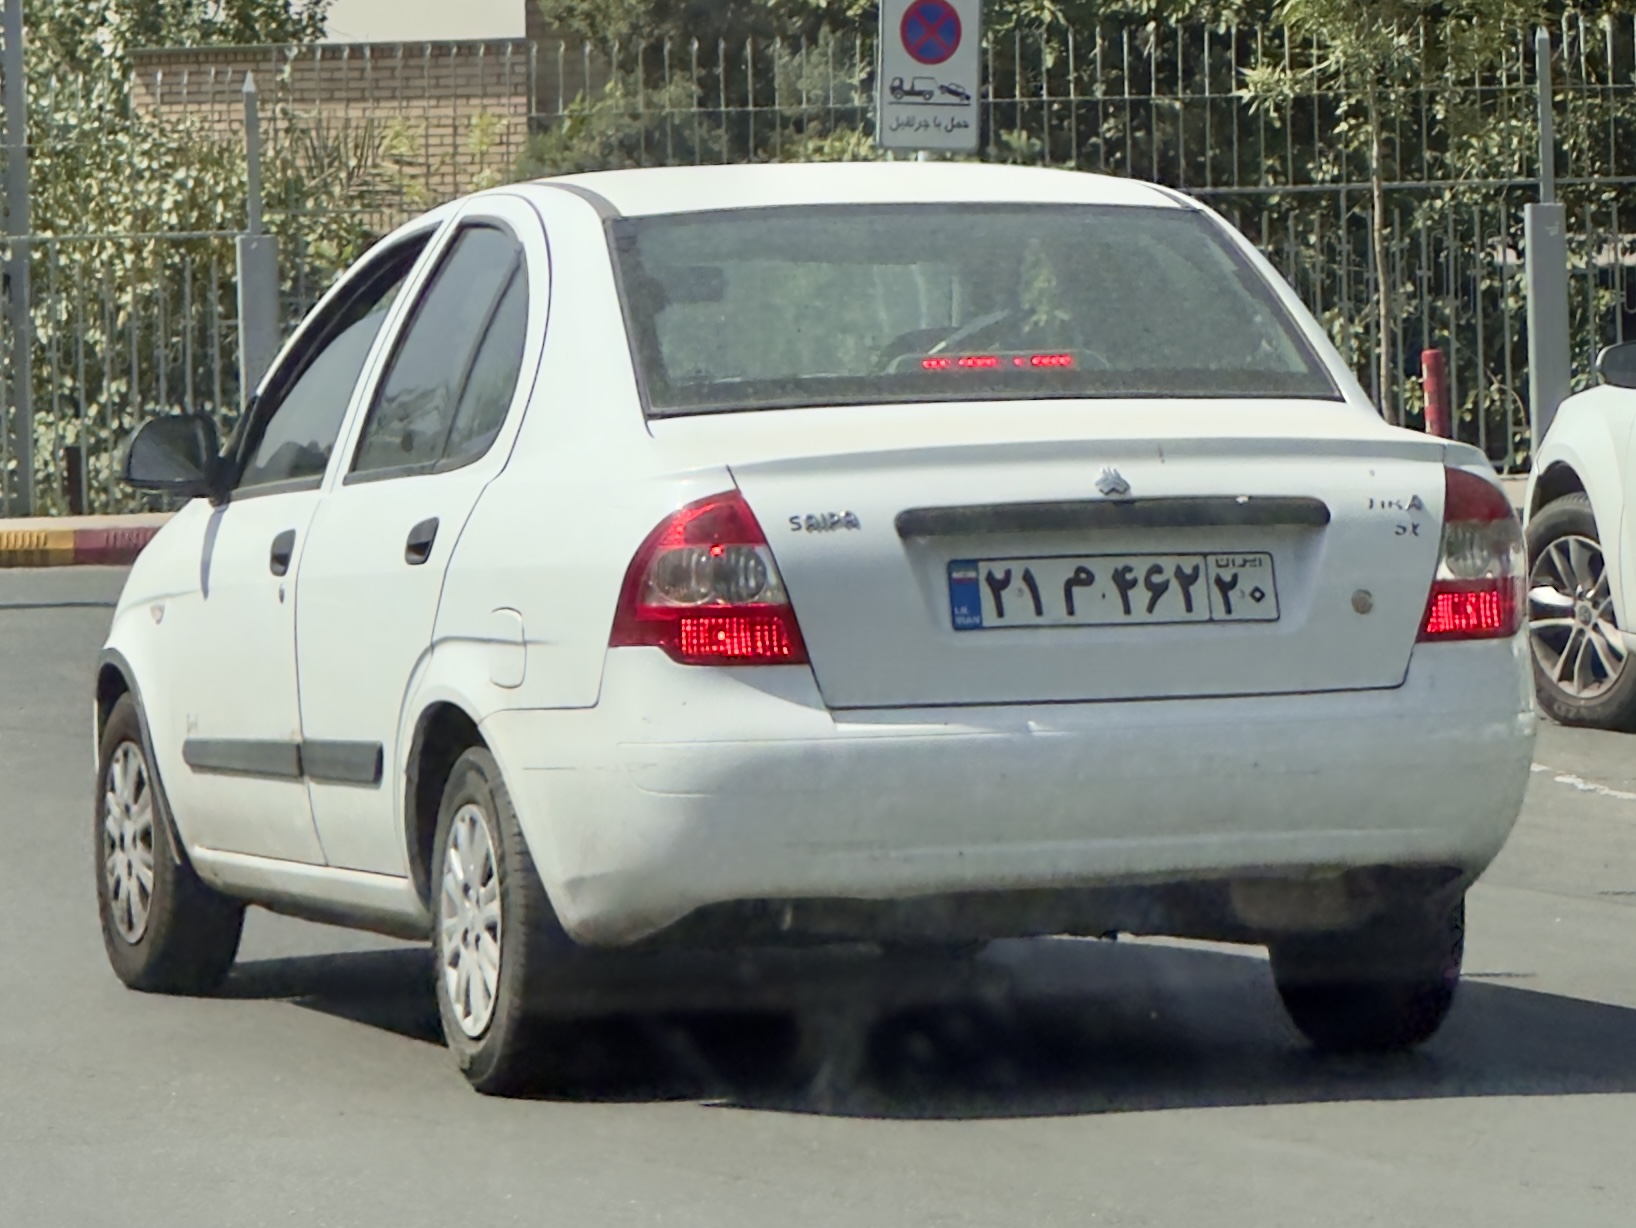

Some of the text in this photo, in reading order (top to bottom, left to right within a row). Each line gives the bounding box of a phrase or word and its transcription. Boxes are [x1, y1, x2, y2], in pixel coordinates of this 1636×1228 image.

[933, 115, 943, 131] با
[944, 116, 970, 133] حمل
[1215, 557, 1263, 569] ایران
[1213, 572, 1266, 616] ۲۰
